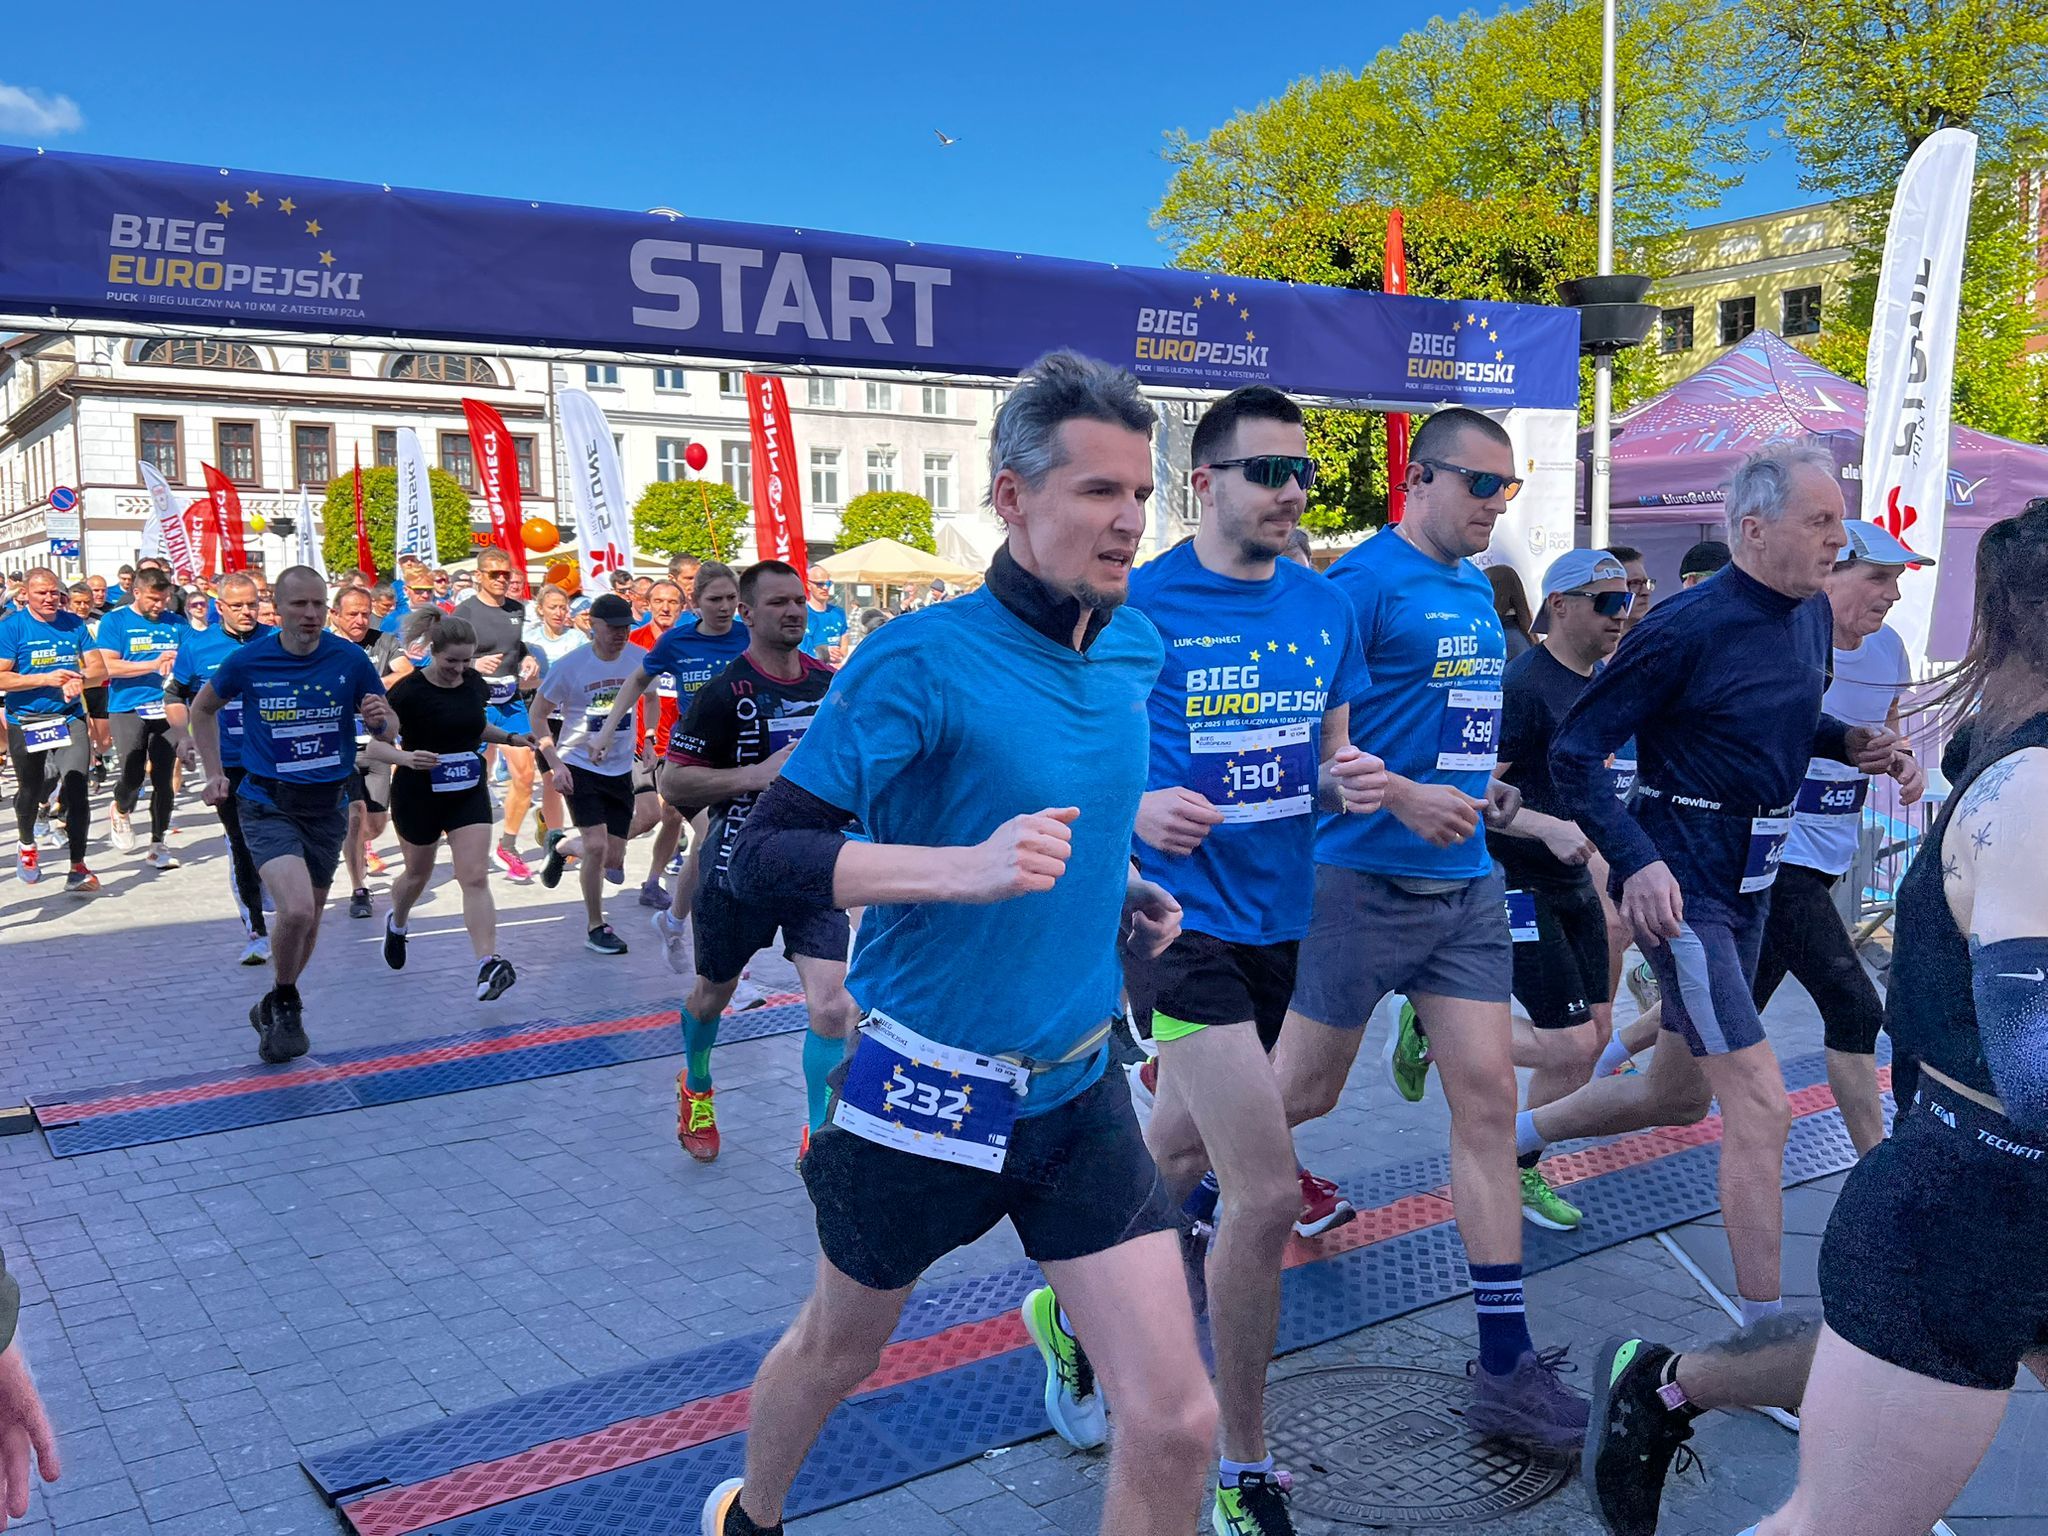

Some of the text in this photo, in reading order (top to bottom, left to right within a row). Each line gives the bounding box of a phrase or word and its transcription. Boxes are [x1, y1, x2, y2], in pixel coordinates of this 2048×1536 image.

[109, 213, 225, 255] BIEG
[108, 254, 363, 300] EUROPEJSKI
[106, 291, 366, 318] PUCK BIEG ULICZNY NA 10 KM Z ATESTEM PZLA
[629, 238, 952, 347] START
[1136, 307, 1199, 336] BIEG
[1135, 337, 1270, 367] EUROPEJSKI
[1408, 332, 1456, 357] BIEG
[1135, 364, 1152, 372] PUCK
[1407, 358, 1516, 383] EUROPEJSKI
[160, 513, 195, 576] ANIECKI
[470, 532, 497, 548] nge
[1173, 635, 1241, 648] LUK-CONNECT
[1437, 635, 1479, 659] BIEG
[682, 670, 712, 683] BIEG
[683, 681, 706, 693] EUR
[1186, 665, 1260, 692] BIEG
[259, 696, 297, 710] BIEG
[259, 705, 344, 722] EUROPEJSKI
[736, 697, 760, 764] TILO
[1204, 718, 1220, 728] 2025
[1225, 717, 1241, 726] BIEG
[1241, 717, 1269, 726] ULICZNY
[1269, 717, 1279, 725] NA
[1462, 719, 1493, 743] 439
[294, 740, 321, 755] 157
[444, 765, 468, 778] 418
[1228, 761, 1280, 791] 130
[1671, 794, 1722, 811] newline
[1822, 789, 1857, 807] 459
[878, 1017, 893, 1031] BIEG
[885, 1072, 969, 1122] 232
[1976, 1128, 2045, 1160] TECHFIT
